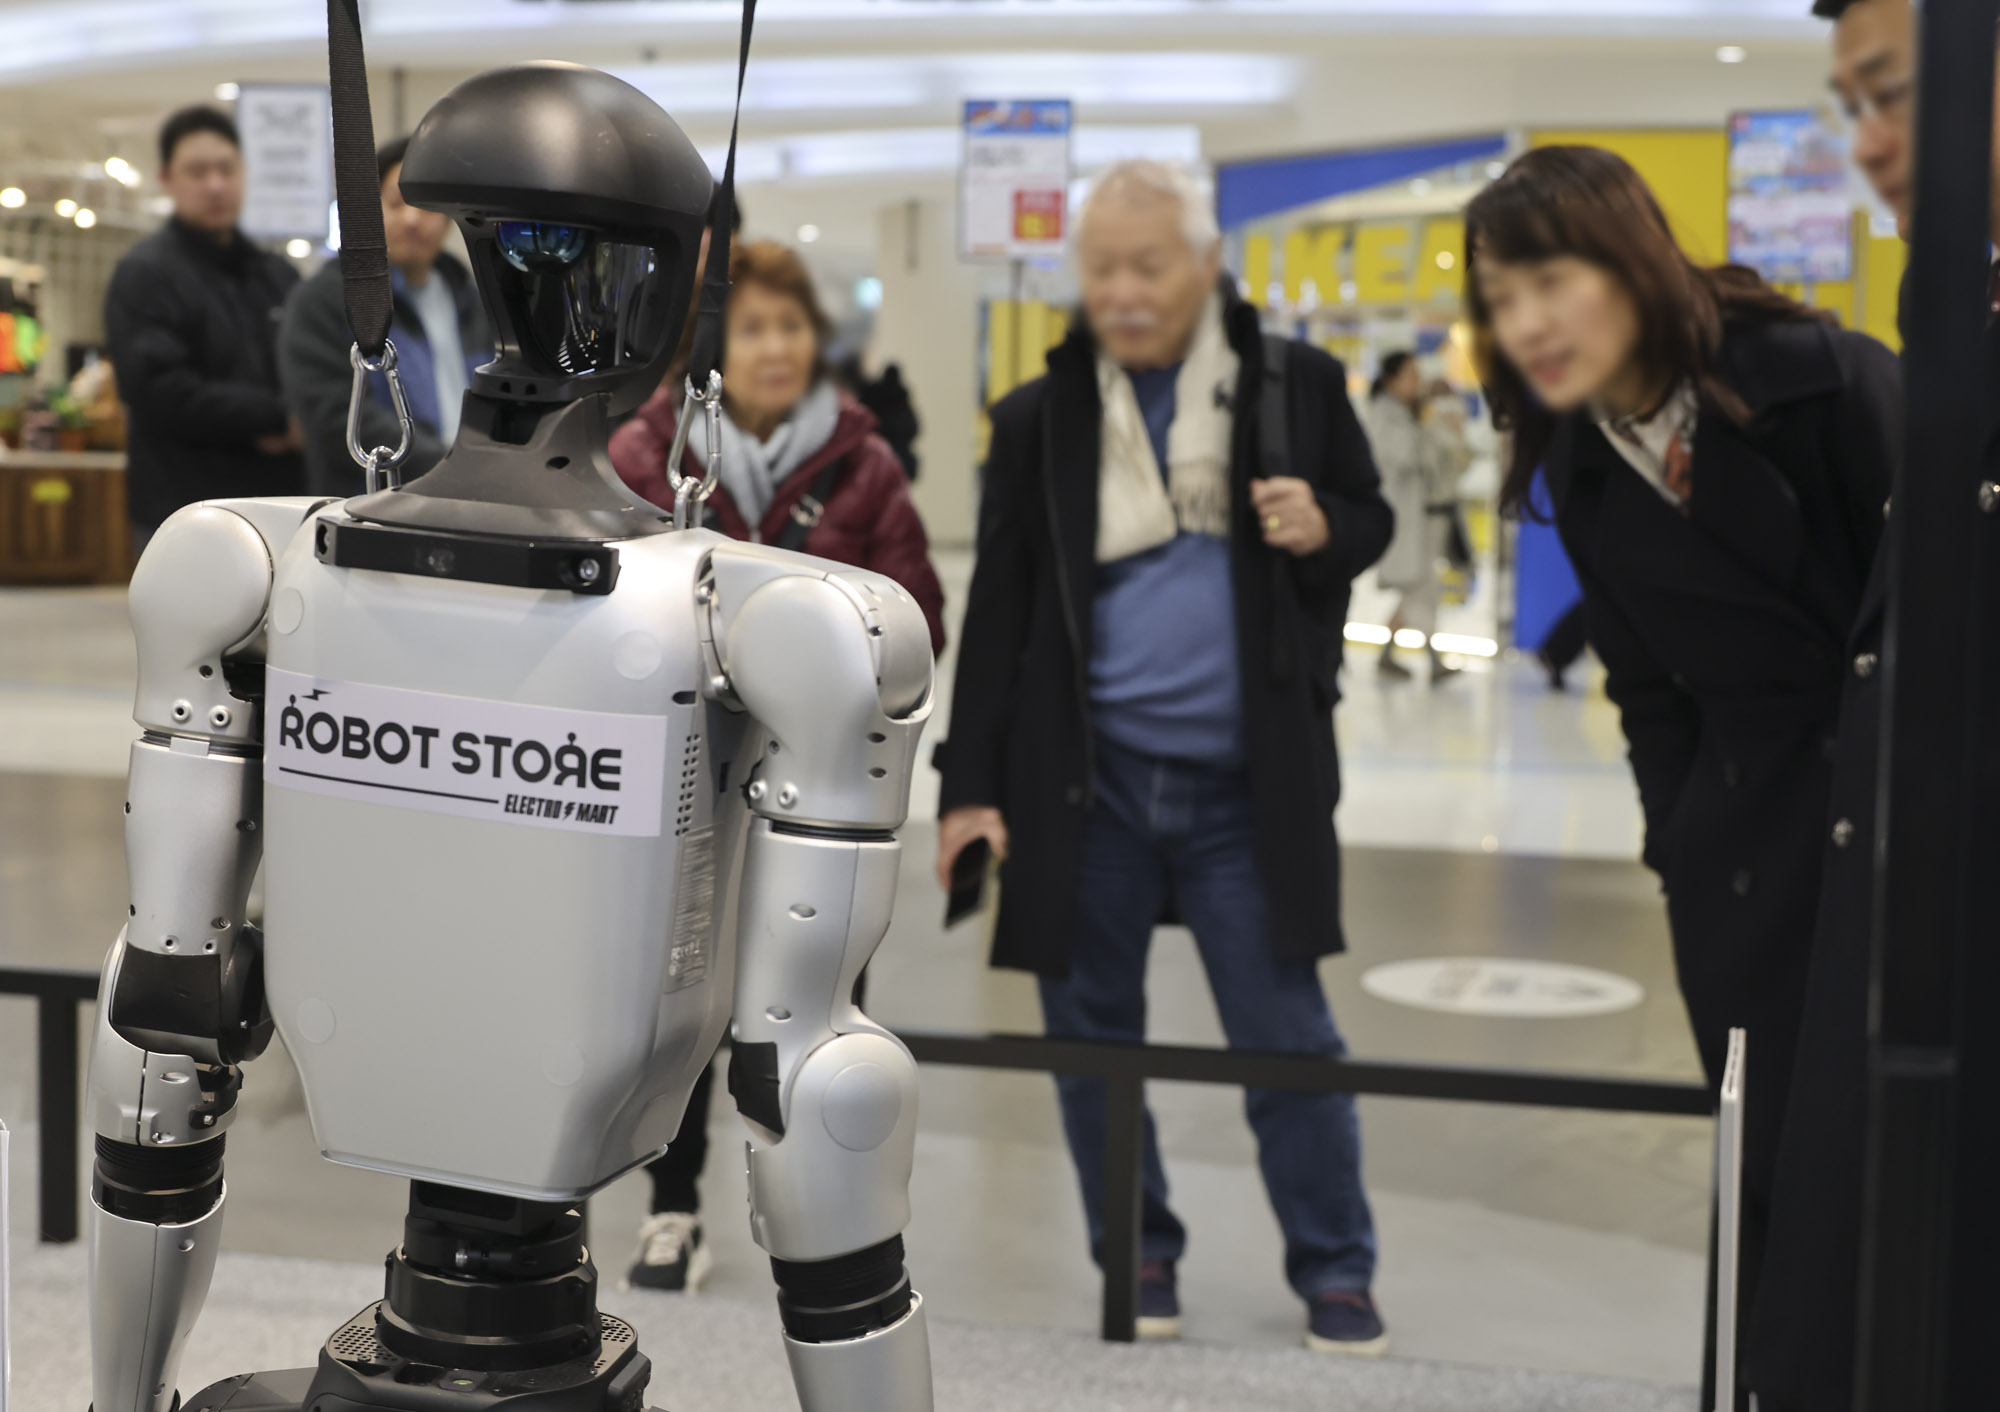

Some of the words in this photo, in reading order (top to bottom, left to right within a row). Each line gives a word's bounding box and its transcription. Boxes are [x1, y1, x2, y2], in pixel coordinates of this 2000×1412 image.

[1244, 220, 1466, 305] IKEA
[280, 696, 440, 769] ROBOT
[504, 794, 563, 820] ELECTRO
[575, 803, 619, 825] MART
